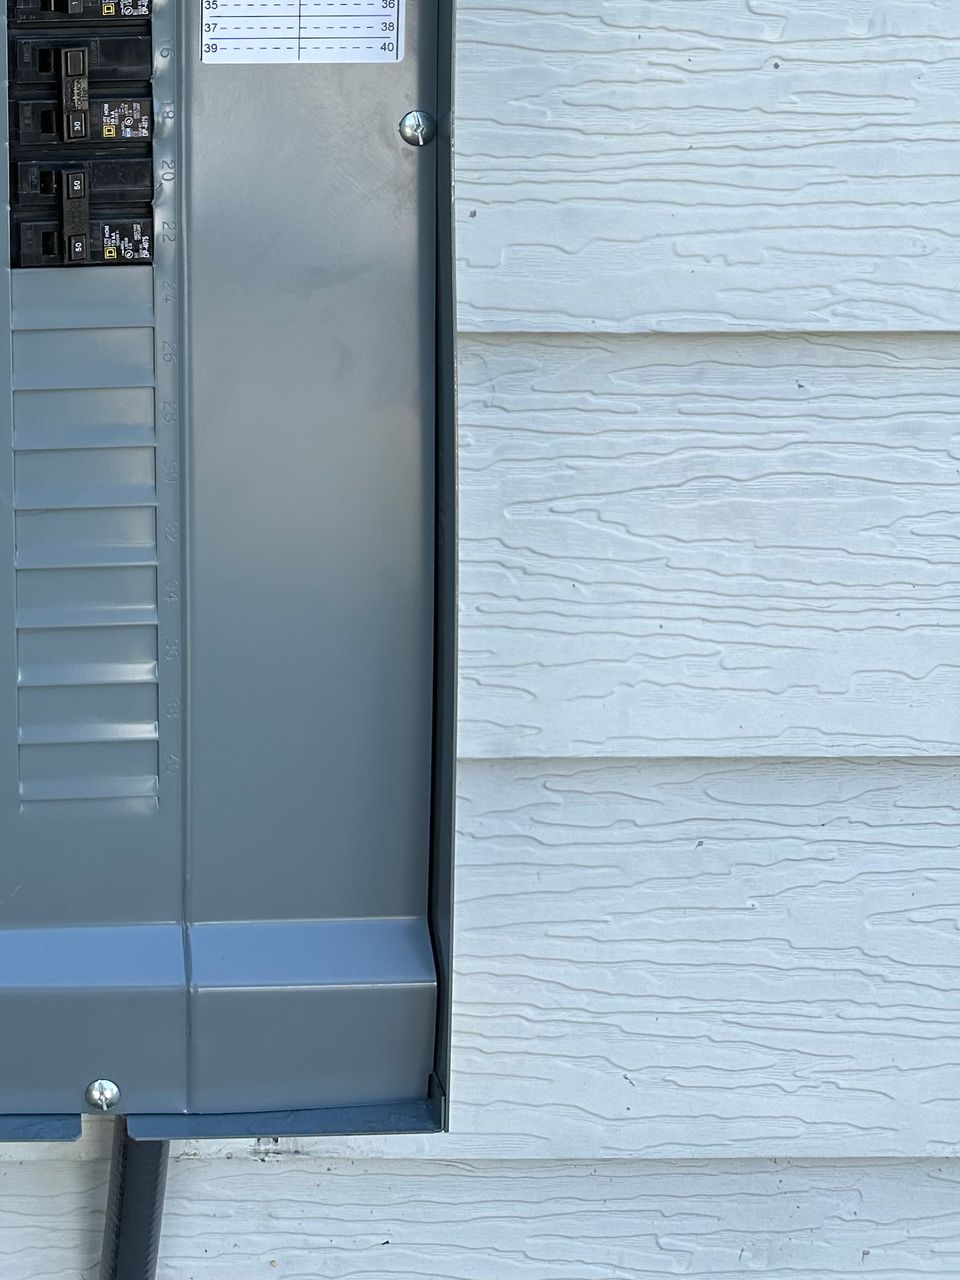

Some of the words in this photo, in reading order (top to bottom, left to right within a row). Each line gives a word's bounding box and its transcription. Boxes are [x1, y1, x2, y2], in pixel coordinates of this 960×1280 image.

[205, 0, 218, 10] 35
[382, 0, 395, 8] 36
[204, 23, 218, 32] 37
[381, 22, 394, 31] 38
[204, 44, 217, 53] 39
[380, 42, 394, 52] 40
[74, 122, 81, 131] 30
[74, 180, 81, 190] 50
[75, 242, 82, 252] 50
